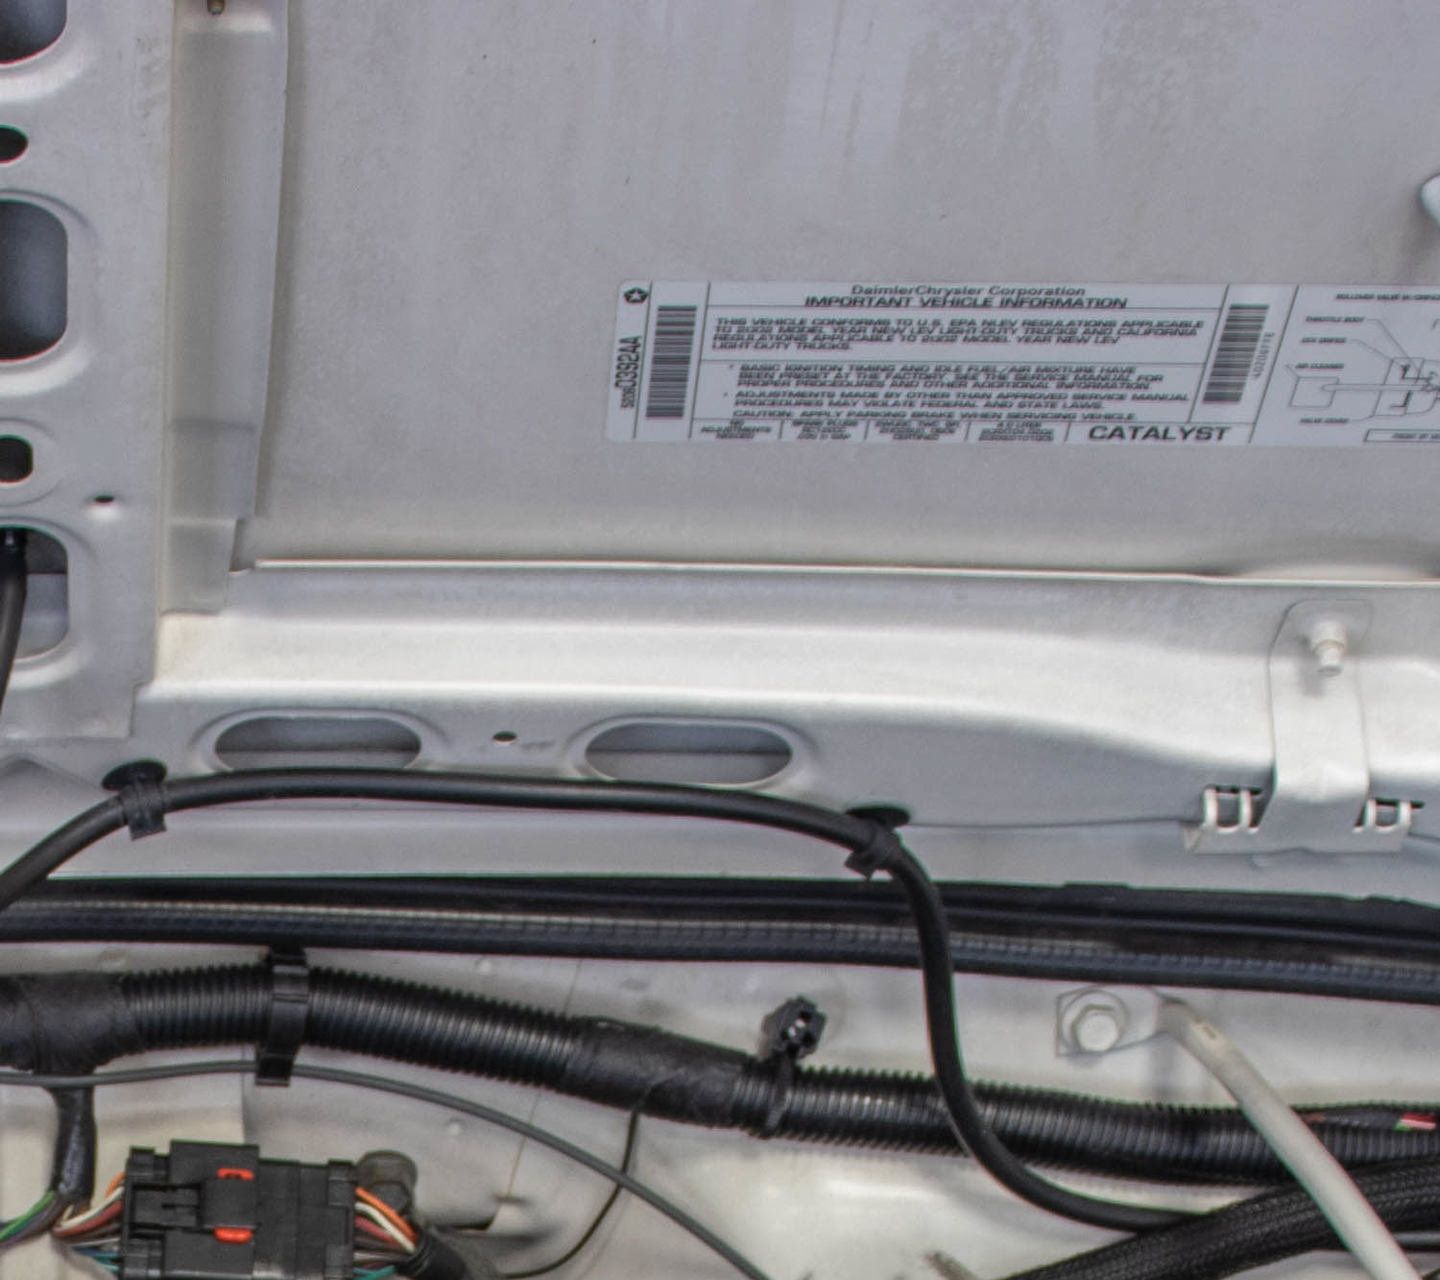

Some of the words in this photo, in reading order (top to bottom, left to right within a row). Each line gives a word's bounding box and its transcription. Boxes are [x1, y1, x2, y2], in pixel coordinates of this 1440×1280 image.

[851, 284, 983, 298] DaimlerChrysler
[988, 285, 1086, 298] Corporation
[804, 296, 914, 308] IMPORTANT
[920, 297, 992, 309] VEHICLE
[1000, 297, 1127, 309] INFORMATION
[717, 318, 747, 326] THIS
[752, 318, 807, 326] VEHICLE
[811, 319, 890, 327] CONFORMS
[896, 319, 912, 327] TO
[950, 319, 976, 327] EPA
[981, 319, 1017, 327] NLEV
[1021, 319, 1117, 327] REGULATIONS
[1121, 320, 1205, 328] APPLICABLE
[716, 326, 732, 334] TO
[777, 326, 823, 334] MODEL
[833, 327, 867, 335] YEAR
[871, 327, 906, 335] NEW
[911, 327, 935, 335] LEV
[939, 327, 976, 335] LIGHT
[981, 327, 1017, 335] DUTY
[1023, 327, 1077, 335] TRUCKS
[1082, 328, 1113, 336] AND
[1116, 328, 1198, 336] CALIFORNIA
[713, 334, 808, 342] REGULATIONS
[812, 335, 893, 343] APPLICABLE
[899, 335, 917, 343] TO
[1017, 336, 1051, 344] YEAR
[1055, 336, 1090, 344] NEW
[1094, 336, 1120, 344] LEV
[712, 342, 750, 350] LIGHT
[754, 342, 790, 350] DUTY
[740, 364, 780, 372] BASIC
[785, 364, 845, 372] IGNITION
[851, 365, 895, 373] TIMING
[899, 365, 930, 373] AND
[934, 365, 961, 373] IDLE
[968, 365, 1031, 373] FUEL/AIR
[1035, 366, 1095, 374] MIXTURE
[1099, 366, 1136, 374] HAVE
[1088, 425, 1231, 441] CATALYST
